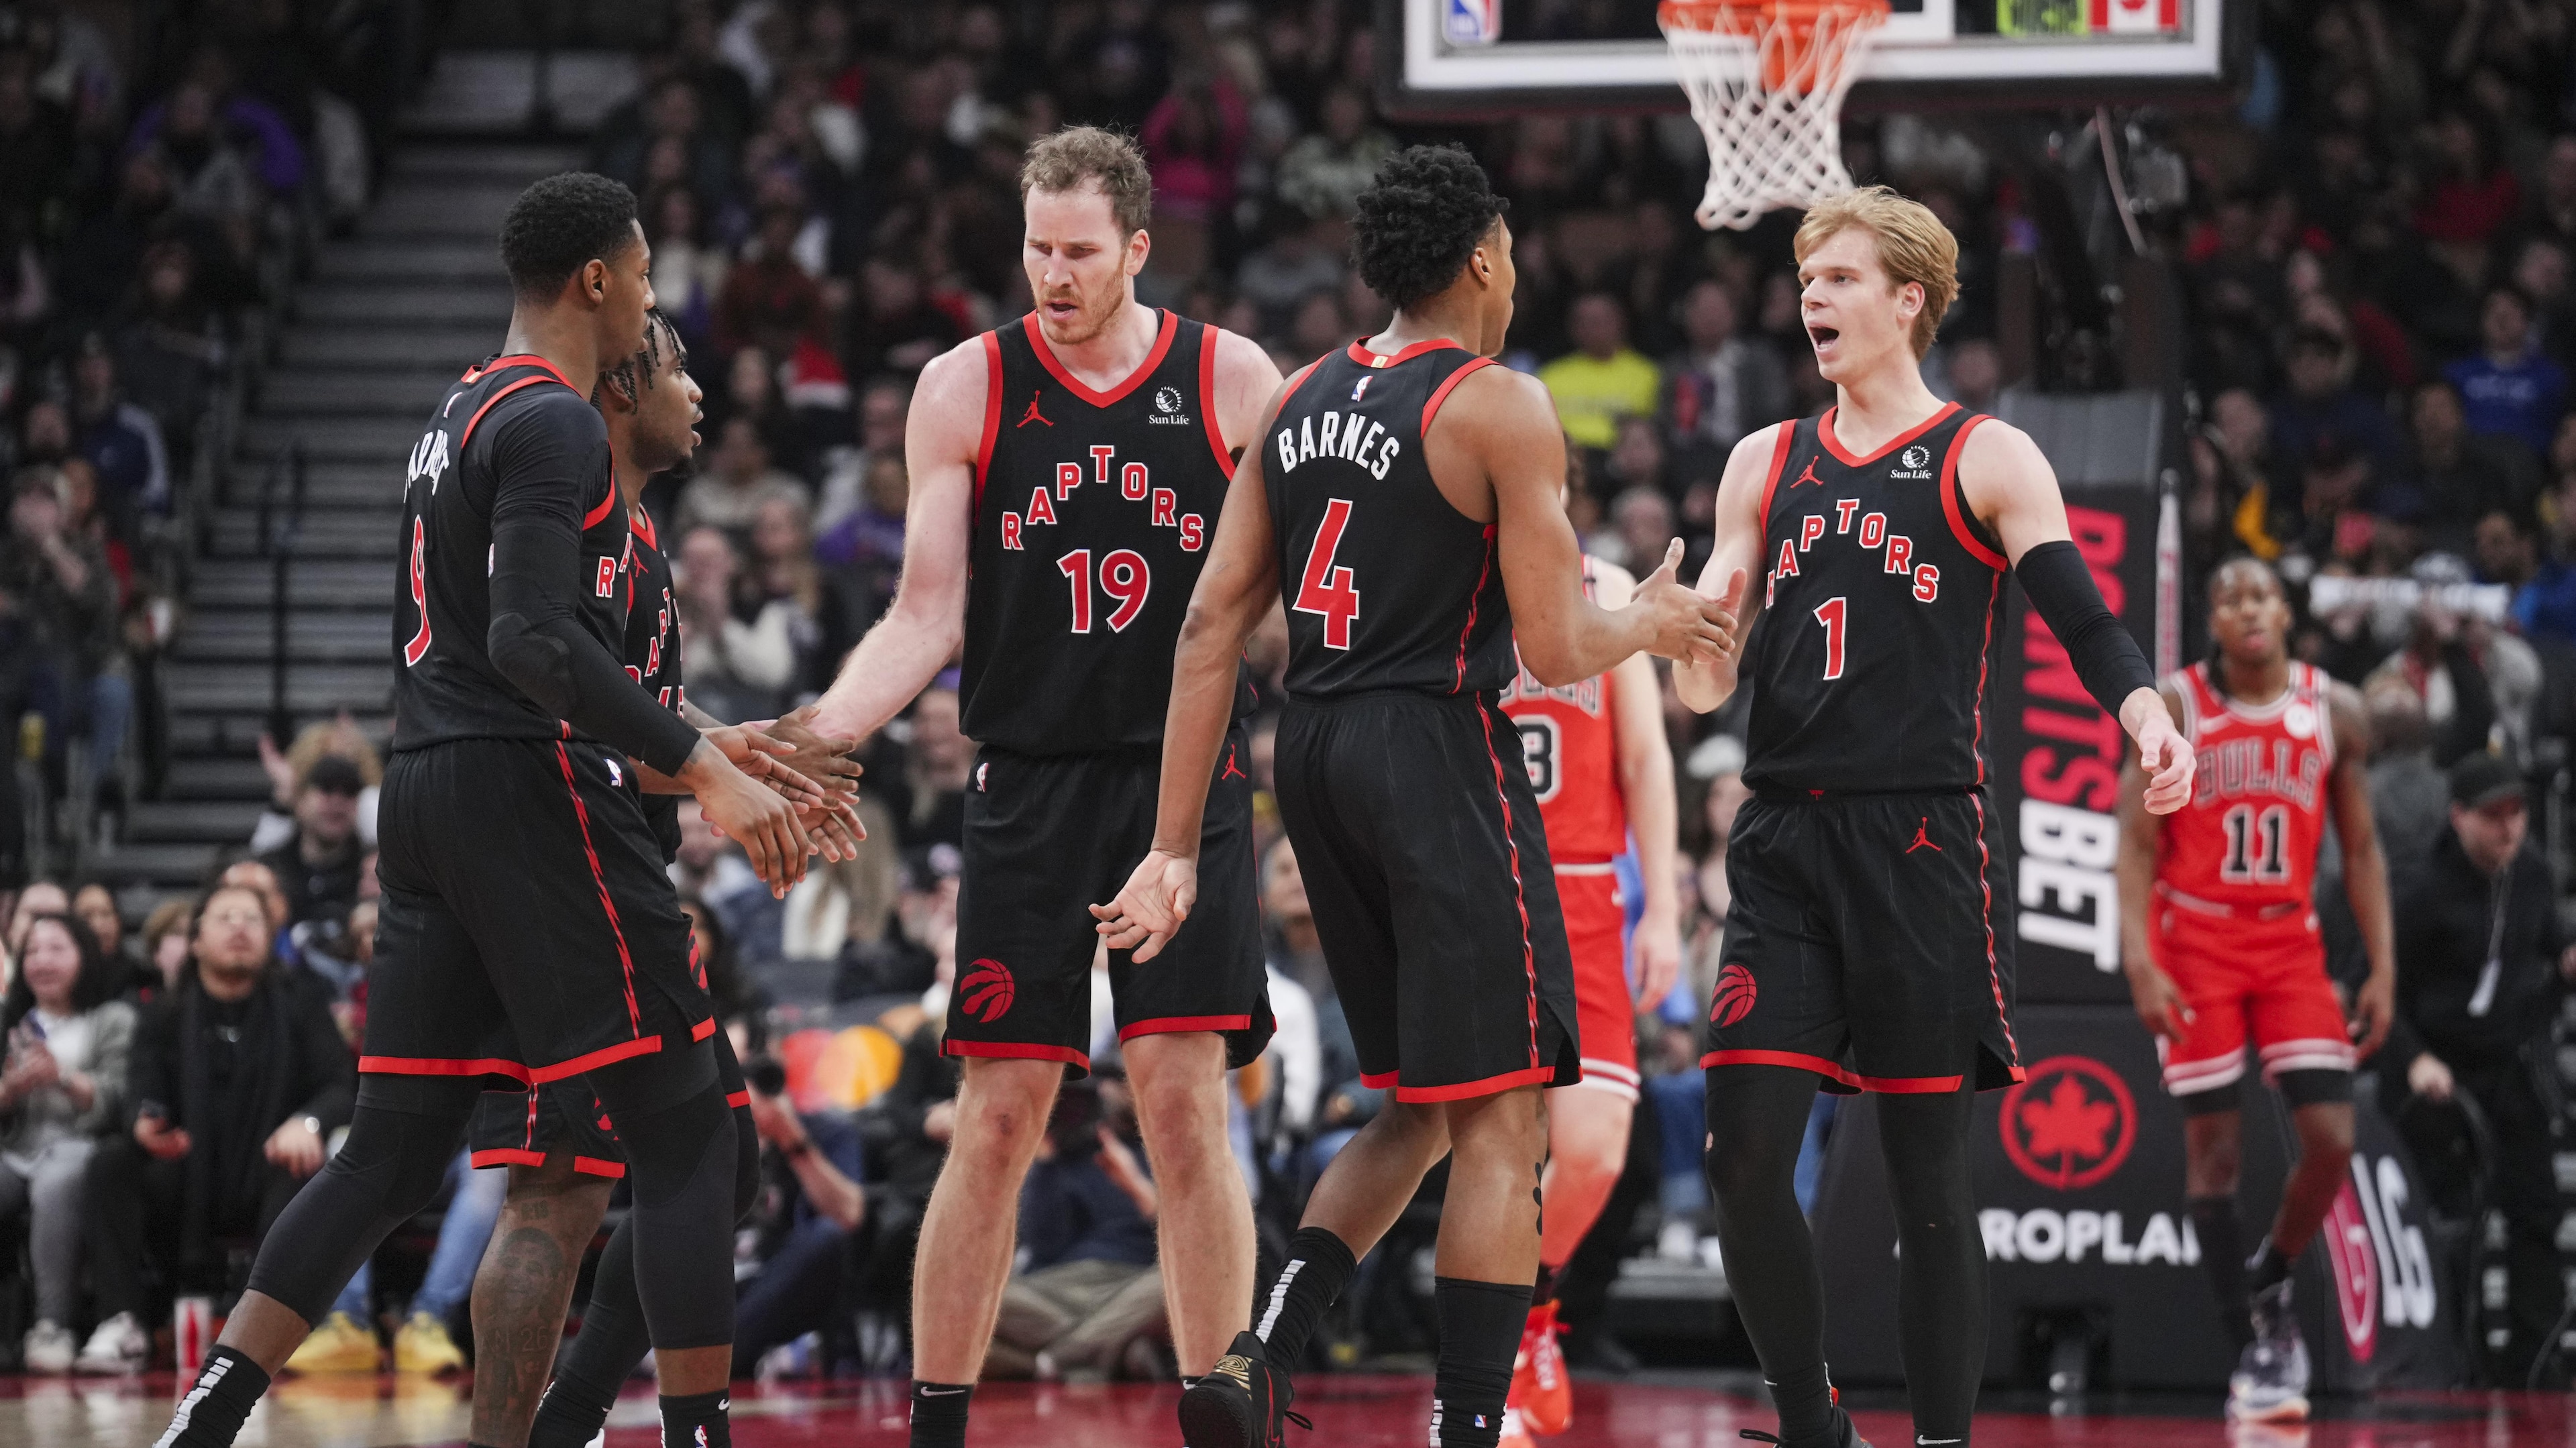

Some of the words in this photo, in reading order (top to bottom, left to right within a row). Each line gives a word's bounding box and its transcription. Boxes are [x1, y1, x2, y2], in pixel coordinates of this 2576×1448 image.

[1148, 414, 1169, 424] Sun
[1170, 414, 1189, 425] Life
[1278, 411, 1399, 480] BARNES
[1002, 445, 1203, 551] RAPTORS
[1890, 469, 1911, 479] Sun
[1912, 469, 1932, 480] Life
[404, 514, 431, 667] 9
[1056, 549, 1150, 634] 19
[1291, 498, 1360, 651] 4
[1765, 498, 1939, 609] RAPTORS
[1813, 596, 1847, 681] 1
[2194, 736, 2322, 813] BULLS
[2221, 804, 2290, 883] 11
[1893, 1207, 2202, 1266] ROPLA
[2351, 1152, 2437, 1331] LG
